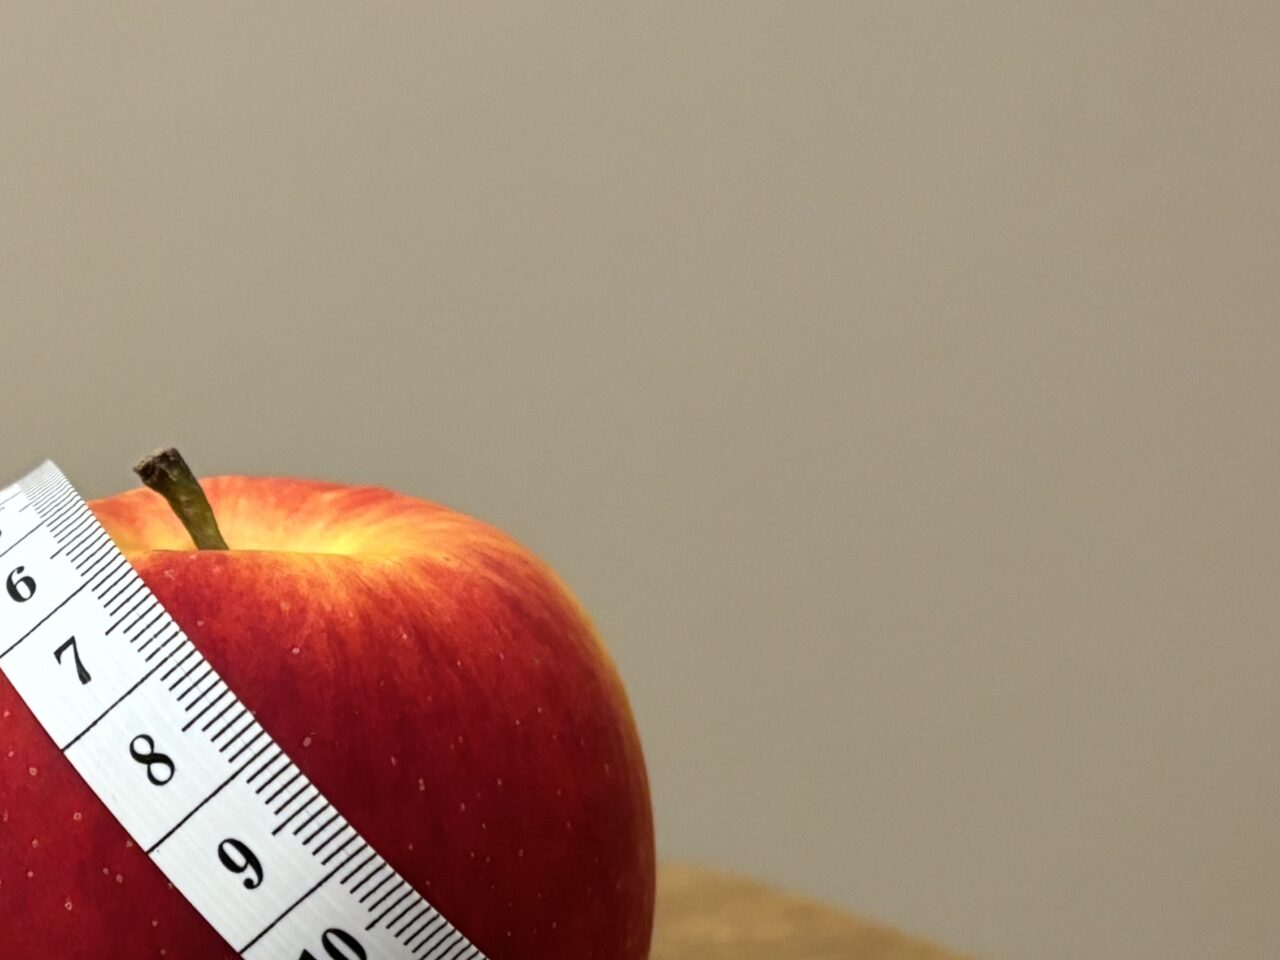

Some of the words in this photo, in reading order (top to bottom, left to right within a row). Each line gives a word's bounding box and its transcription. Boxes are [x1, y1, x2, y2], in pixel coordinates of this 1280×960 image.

[6, 566, 36, 602] 6
[53, 635, 92, 685] 7
[129, 734, 175, 786] 8
[217, 838, 264, 890] 9
